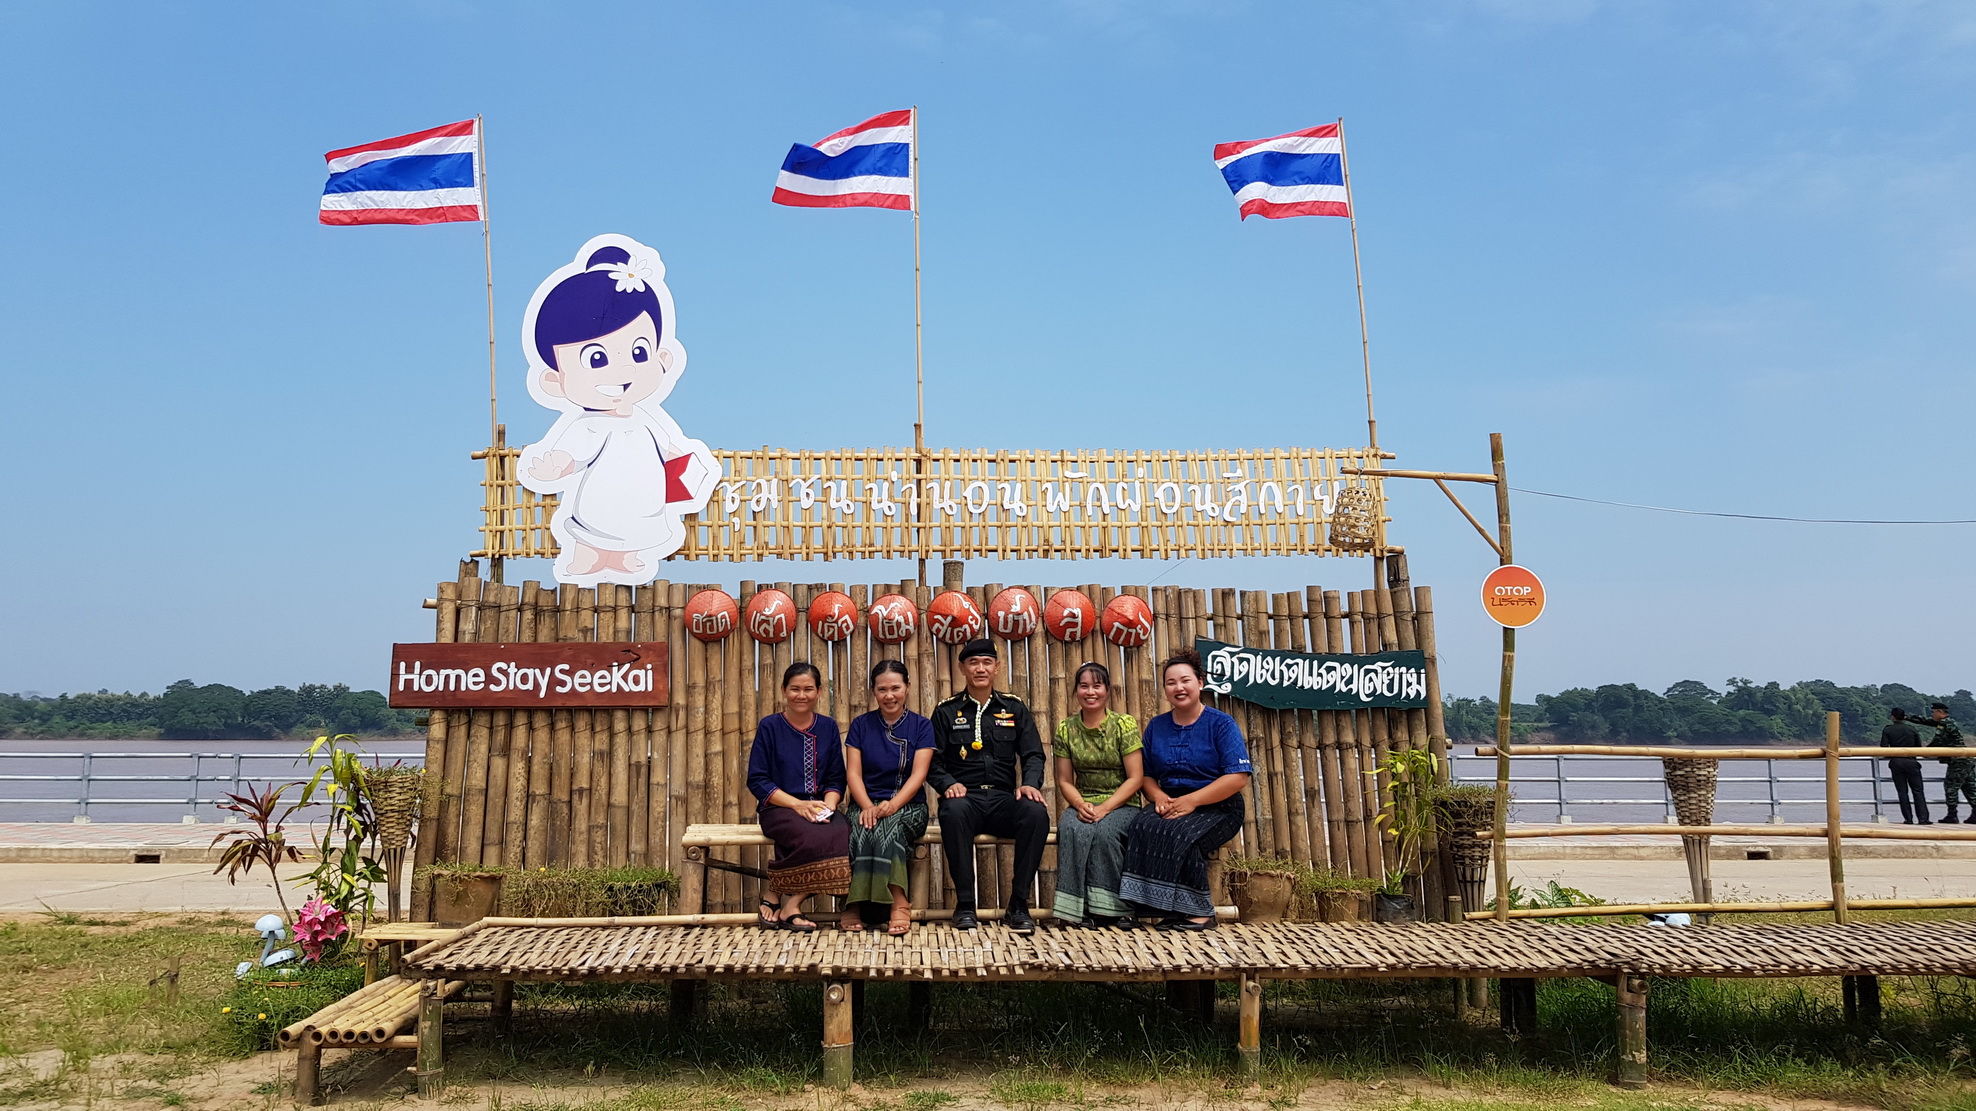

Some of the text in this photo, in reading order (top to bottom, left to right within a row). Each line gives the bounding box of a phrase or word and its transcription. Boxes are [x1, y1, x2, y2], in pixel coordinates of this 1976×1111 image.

[1495, 586, 1532, 596] OTOP
[750, 600, 787, 637] แล้ว
[870, 602, 915, 639] โฮม
[997, 594, 1035, 634] บ้าน
[1108, 611, 1151, 646] กาย
[399, 661, 653, 698] Home Stay SeeKai
[1202, 646, 1427, 702] สุดเขตแดนสยาม
